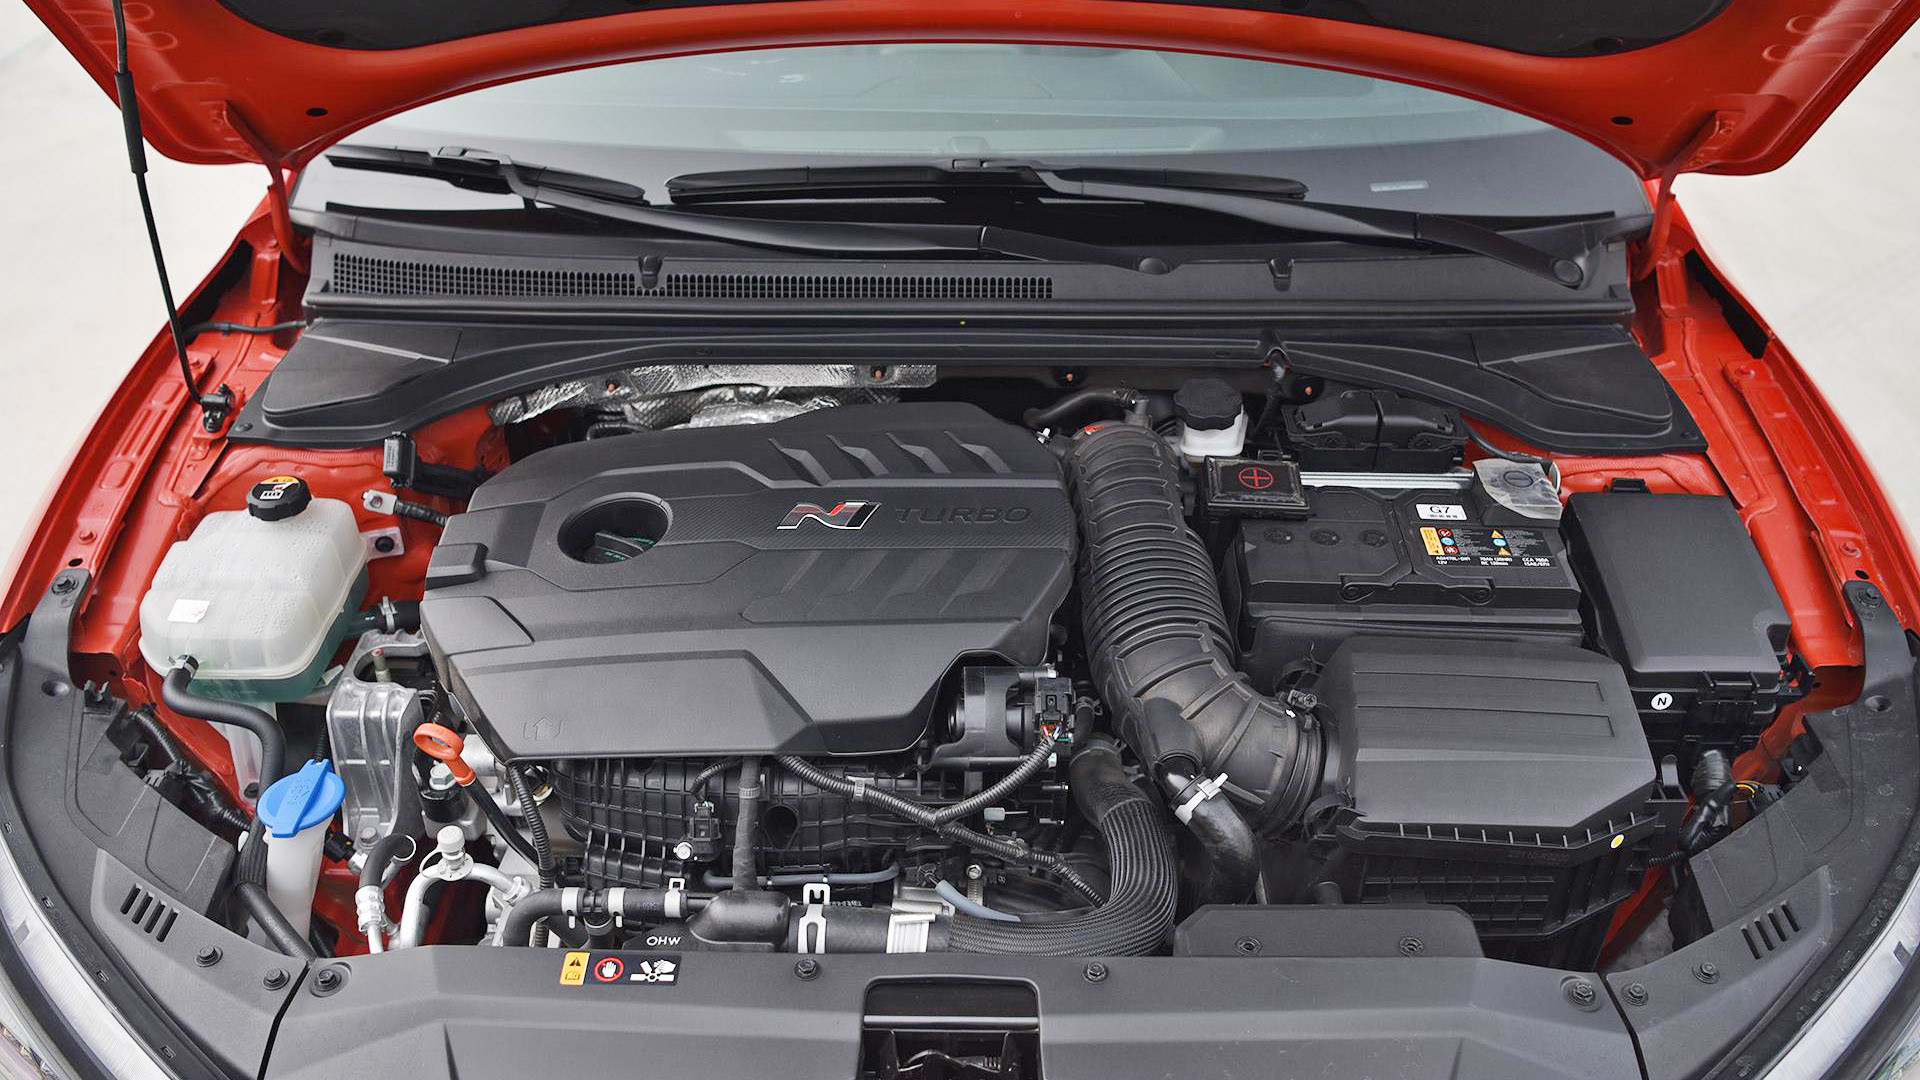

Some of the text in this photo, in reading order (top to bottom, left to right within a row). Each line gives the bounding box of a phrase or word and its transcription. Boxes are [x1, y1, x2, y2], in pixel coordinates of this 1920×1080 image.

[1430, 505, 1450, 513] G7
[895, 507, 1032, 523] TURBO
[1657, 697, 1667, 706] N
